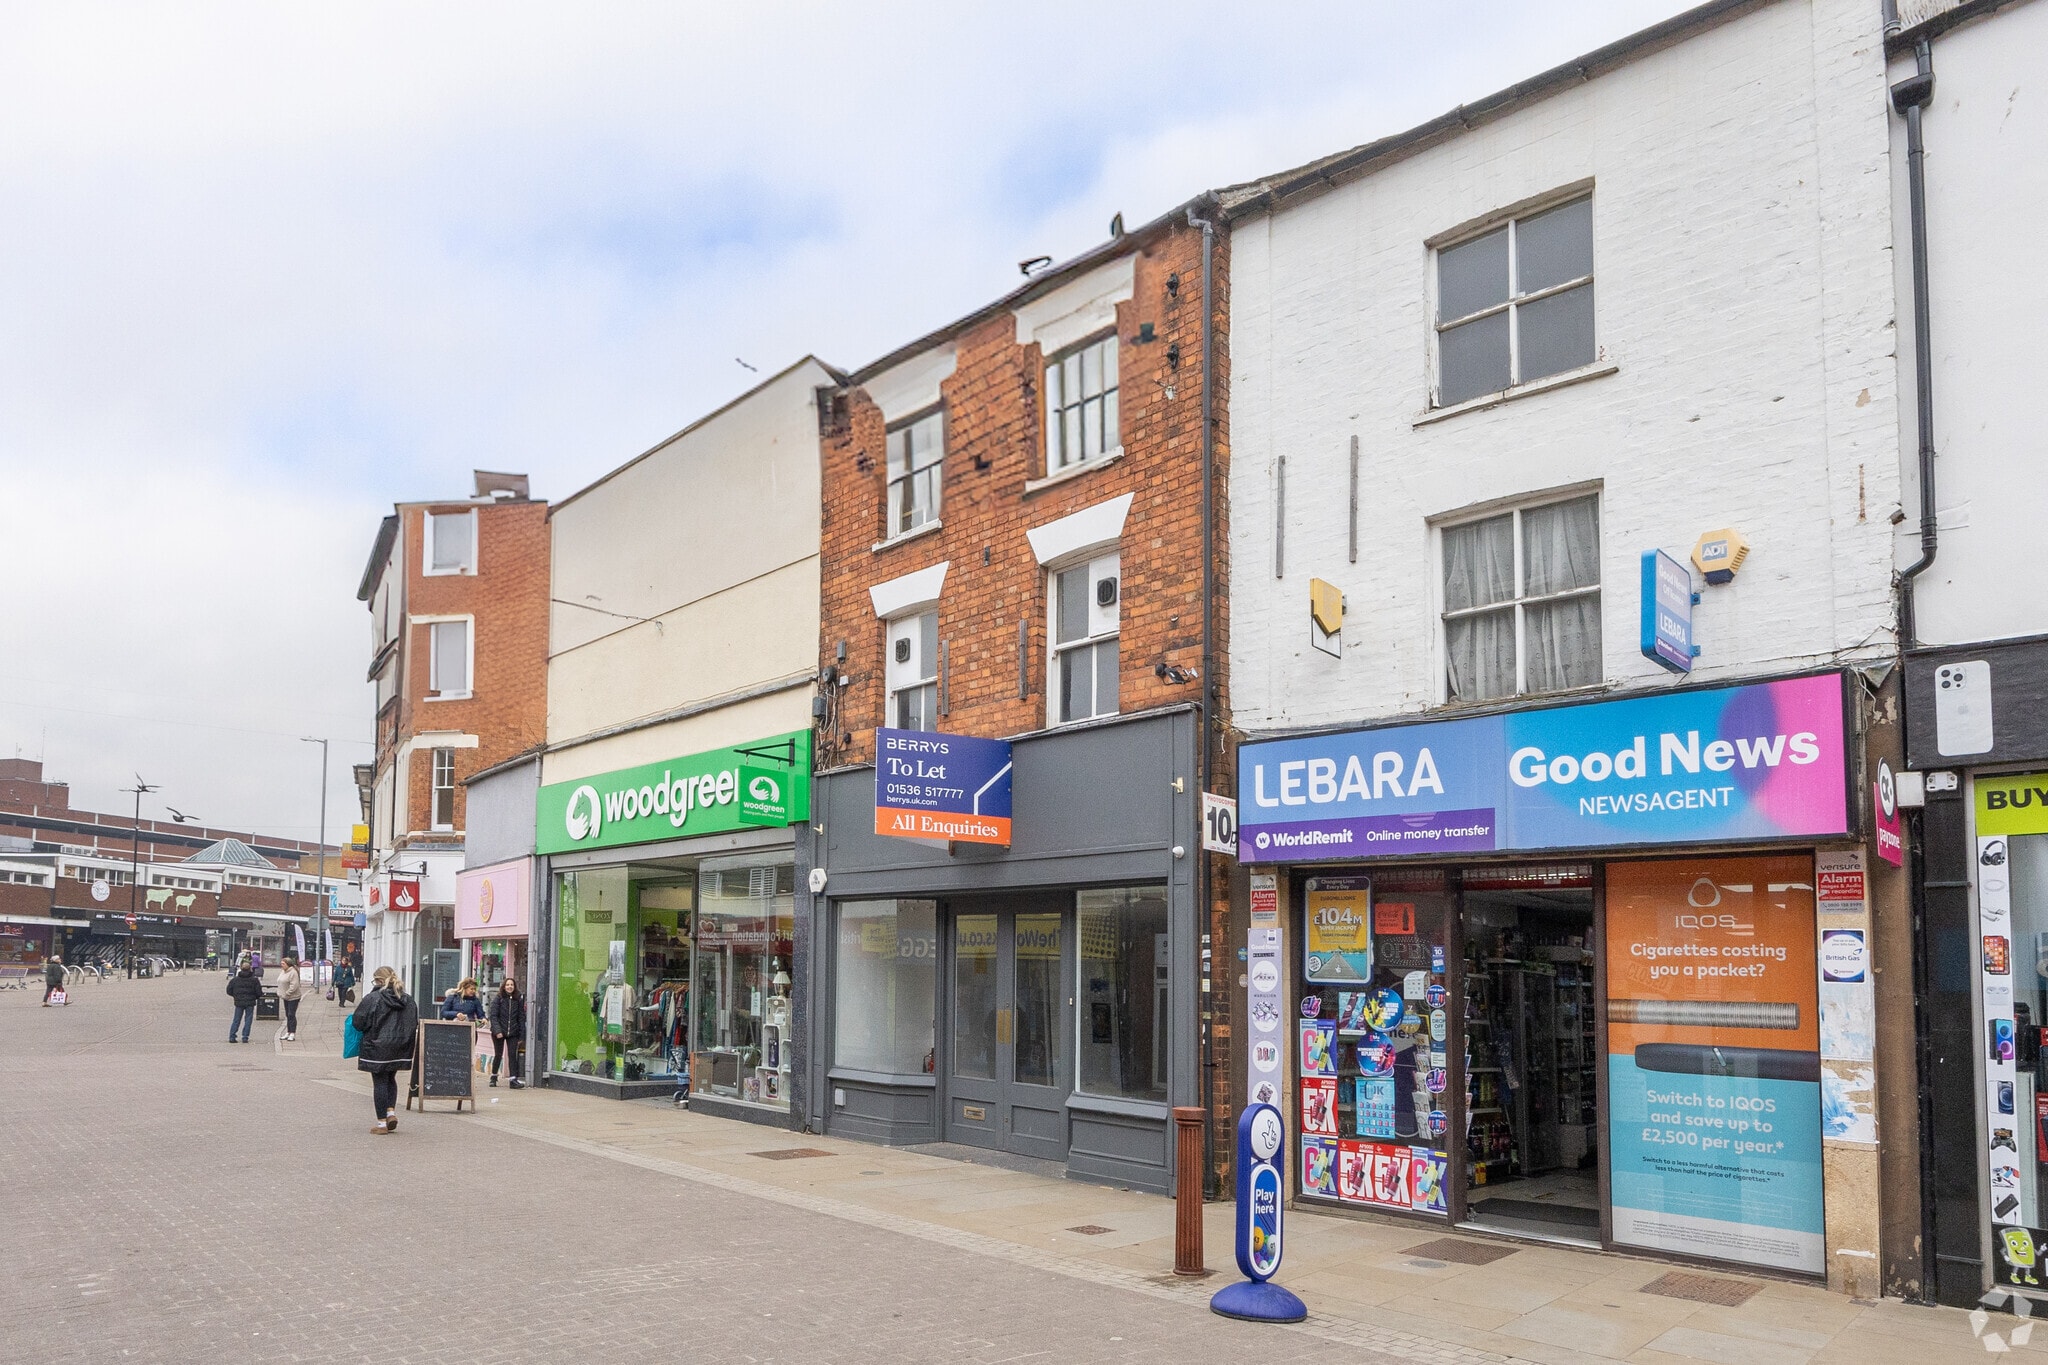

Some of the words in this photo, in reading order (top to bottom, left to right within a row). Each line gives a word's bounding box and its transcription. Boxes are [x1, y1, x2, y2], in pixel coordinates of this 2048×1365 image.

[1703, 542, 1727, 558] ADT
[1660, 612, 1687, 645] LEBARA
[887, 738, 949, 754] BERRYS
[1509, 736, 1646, 788] Good
[1660, 730, 1820, 776] News
[887, 757, 913, 776] To
[917, 760, 946, 779] Let
[1255, 747, 1445, 807] LEBARA
[887, 783, 921, 795] 01536
[925, 787, 964, 799] 517777
[1986, 787, 2048, 810] BUY
[743, 801, 785, 814] woodgreen
[887, 795, 938, 806] berrys.uk.com
[1207, 795, 1236, 807] PHOTOCOPIE
[1579, 787, 1734, 815] NEWSAGENT
[892, 814, 915, 831] All
[921, 816, 998, 838] Enquiries
[1366, 830, 1401, 842] Online
[1404, 829, 1441, 840] money
[1444, 825, 1490, 838] transfer
[1273, 829, 1353, 847] WorldRemit
[1879, 828, 1900, 849] payzone
[1820, 863, 1860, 871] verisure
[1821, 874, 1862, 884] Alarm
[1675, 915, 1735, 929] IQOS
[1630, 943, 1718, 960] Cigarettes
[1722, 943, 1787, 960] costing
[1650, 965, 1679, 979] you
[1683, 966, 1693, 976] a
[1698, 963, 1765, 979] packet?
[1647, 1090, 1702, 1106] Switch
[1707, 1095, 1725, 1108] to
[1730, 1096, 1776, 1113] IQOS
[1651, 1111, 1681, 1124] and
[1685, 1116, 1723, 1128] save
[1728, 1120, 1749, 1134] up
[1754, 1119, 1773, 1133] to
[1642, 1128, 1698, 1146] £2,500
[1702, 1136, 1730, 1151] per
[1642, 1156, 1663, 1164] Switch
[1689, 1161, 1713, 1169] harmful
[1714, 1165, 1749, 1173] alternative
[1256, 1189, 1275, 1203] Play
[1256, 1203, 1274, 1214] here
